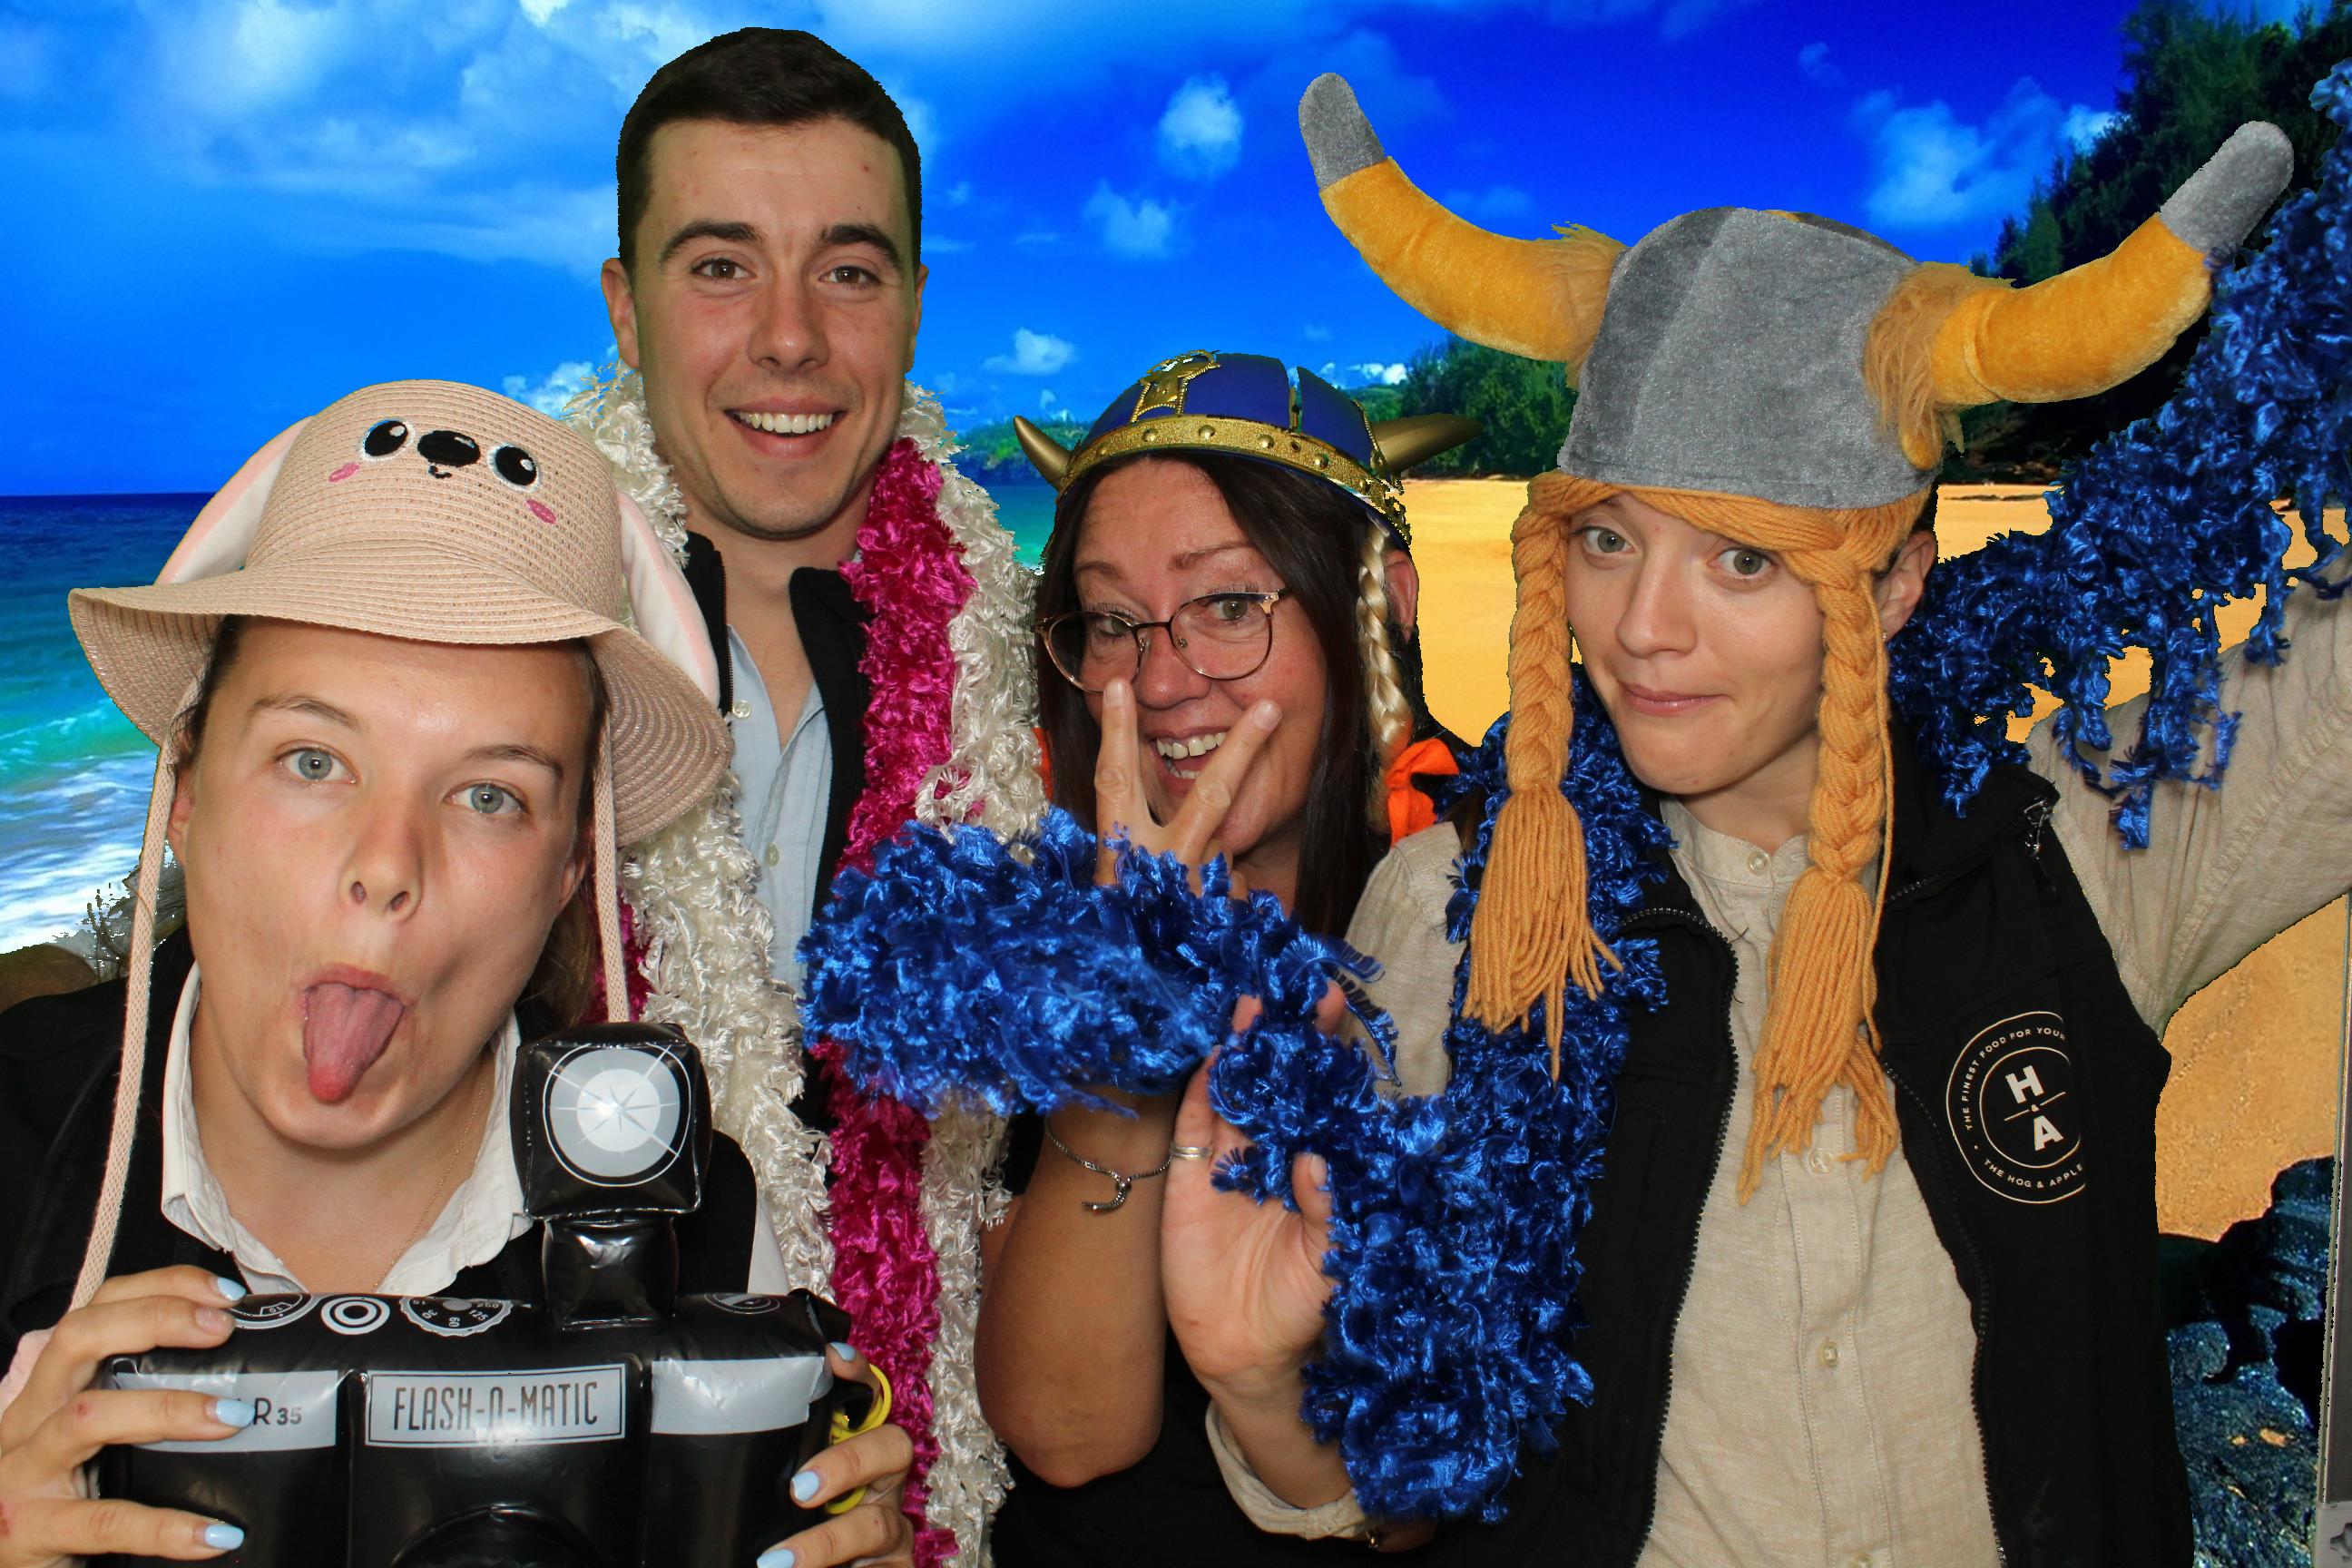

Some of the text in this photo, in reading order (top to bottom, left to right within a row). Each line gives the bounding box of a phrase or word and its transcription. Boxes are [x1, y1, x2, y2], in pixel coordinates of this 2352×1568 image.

[2009, 1028, 2032, 1040] FOR
[1979, 1036, 2007, 1059] FOOD
[1962, 1059, 1980, 1102] FINEST
[2004, 1064, 2044, 1104] H
[1962, 1107, 1973, 1131] THE
[2031, 1103, 2040, 1112] &
[2034, 1115, 2064, 1152] A
[1984, 1159, 2083, 1189] THE HOG & APPLE
[422, 1309, 438, 1319] 30
[448, 1317, 460, 1328] 60
[468, 1309, 489, 1321] 125
[277, 1407, 302, 1426] 35
[393, 1381, 598, 1431] FLASH-O-MATIC
